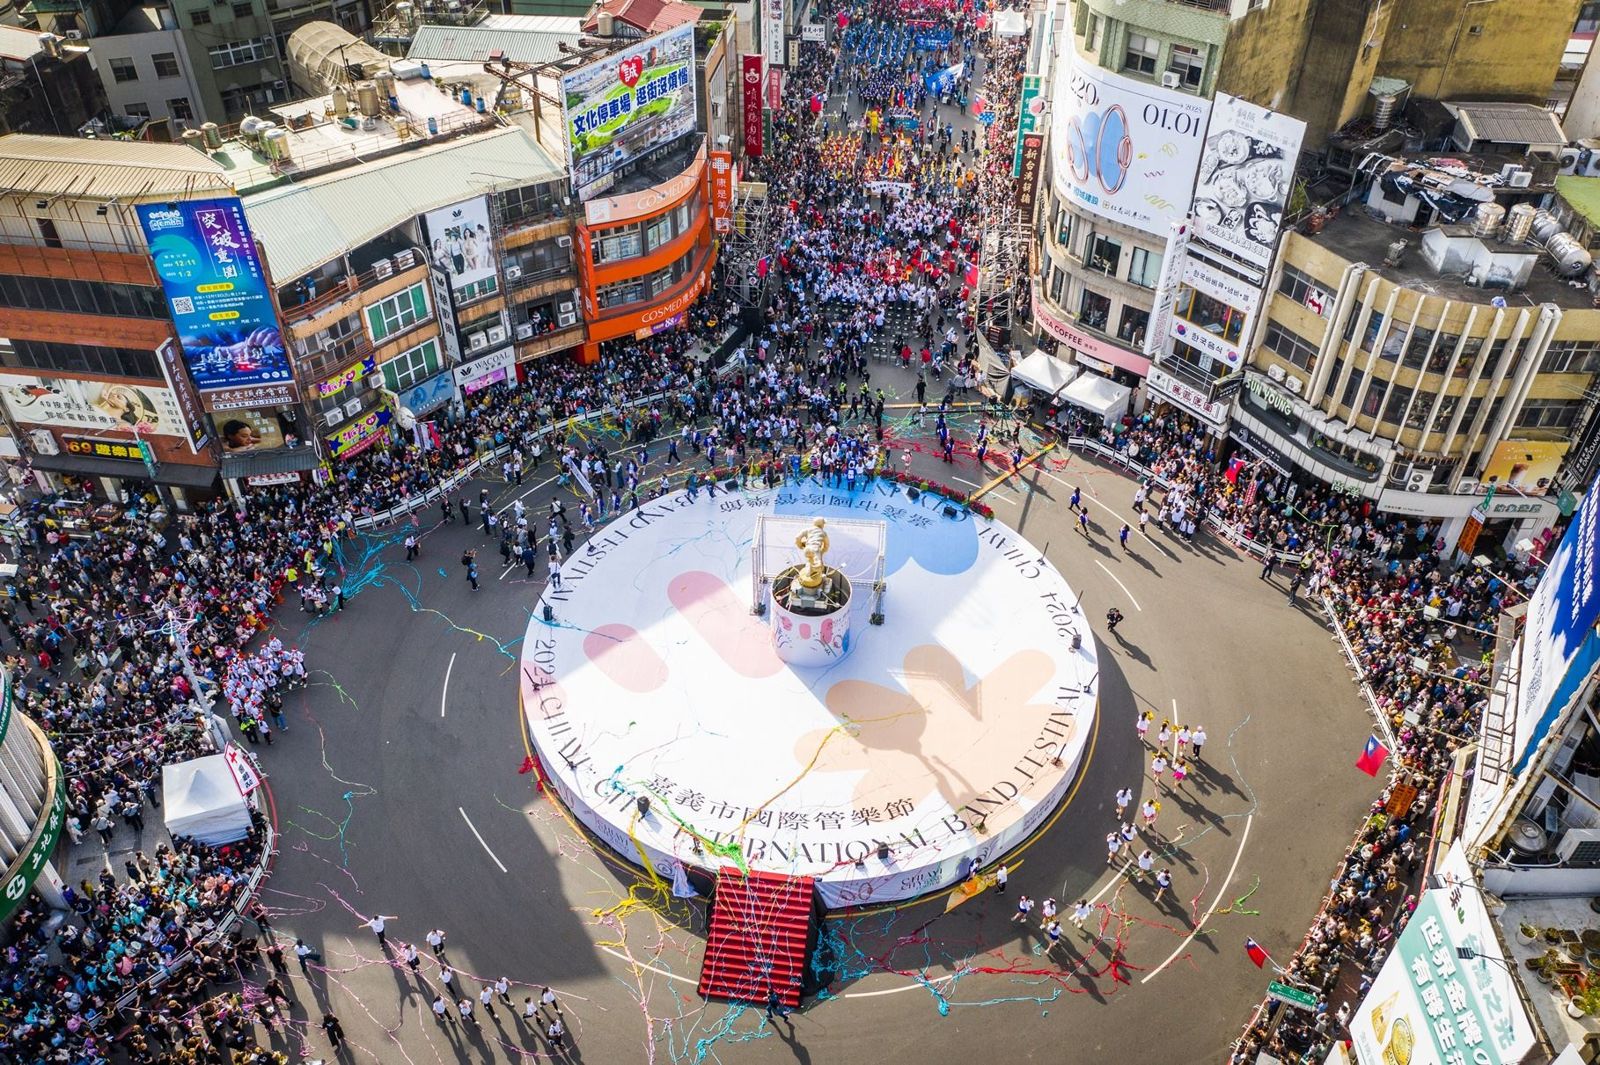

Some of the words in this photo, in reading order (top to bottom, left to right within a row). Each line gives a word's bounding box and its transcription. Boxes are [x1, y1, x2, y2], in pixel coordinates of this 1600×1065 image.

[624, 63, 638, 82] 誠
[573, 93, 632, 137] 文化停車場
[635, 66, 689, 107] 逛街沒煩惱
[746, 87, 759, 147] 噴水雞肉飯
[1142, 103, 1201, 138] 01.01
[716, 178, 727, 210] 康是美
[201, 212, 240, 279] 突破重圍
[641, 298, 682, 324] COSMED
[1054, 325, 1083, 346] COFFEE
[1191, 332, 1223, 355] 한국음식
[474, 351, 511, 370] WACOAL
[1245, 378, 1261, 397] SUN
[1263, 388, 1292, 416] YOUNG
[69, 441, 92, 453] 69
[720, 492, 935, 529] 嘉義市國際管樂節
[978, 526, 1041, 580] CHIAYI
[1039, 591, 1080, 639] 2024
[533, 638, 557, 689] 2024
[540, 695, 592, 769] CHIAYI
[1013, 683, 1083, 780] FESTIVAL
[646, 773, 915, 832] 嘉義市國際管樂節
[940, 780, 1019, 836] BAND
